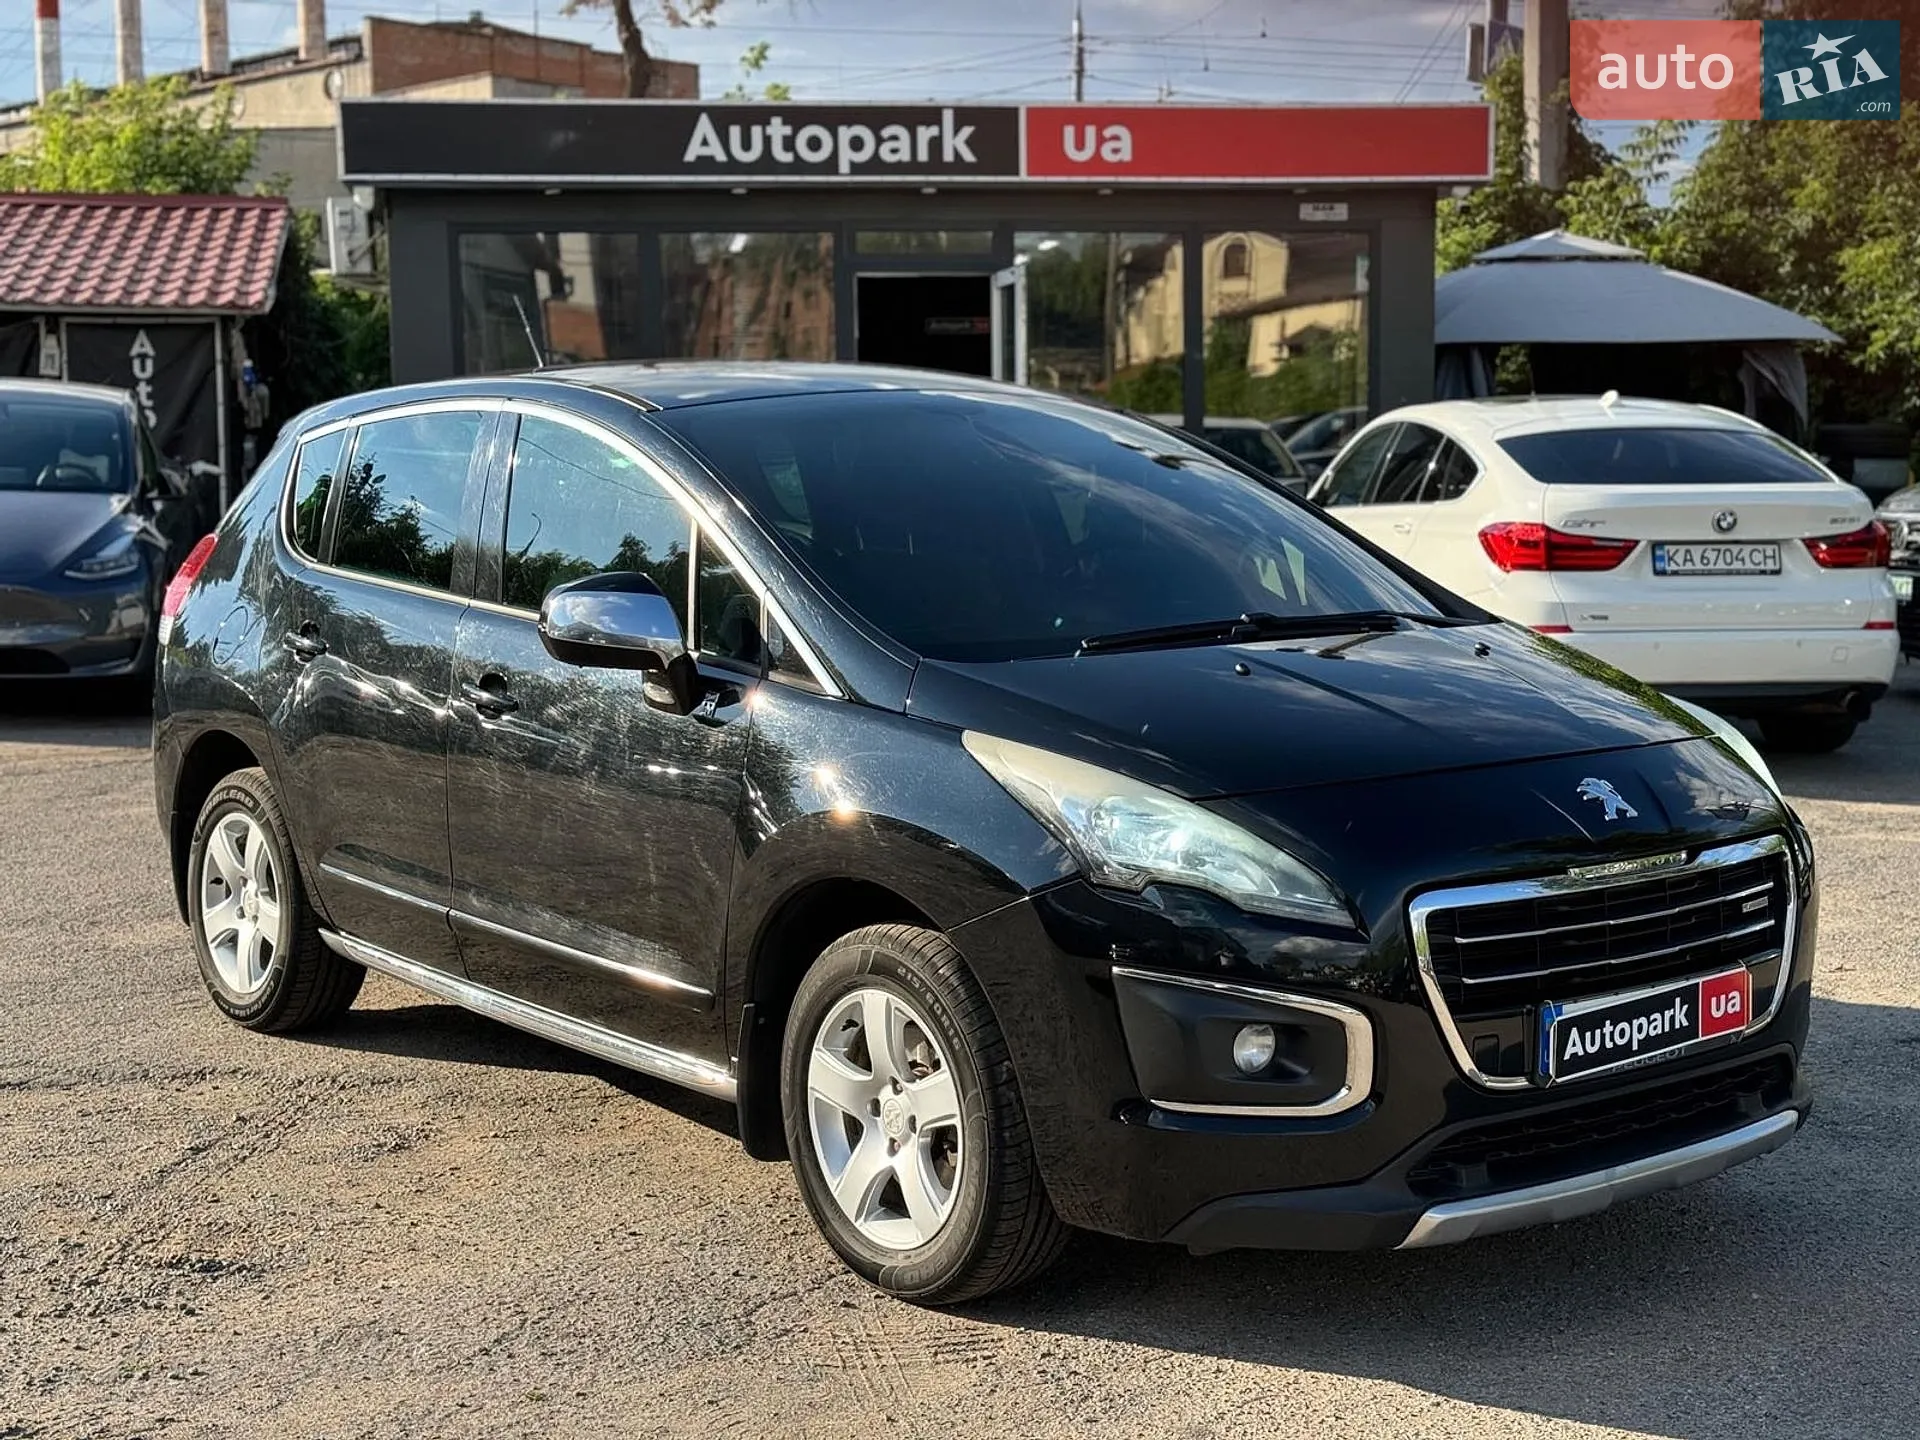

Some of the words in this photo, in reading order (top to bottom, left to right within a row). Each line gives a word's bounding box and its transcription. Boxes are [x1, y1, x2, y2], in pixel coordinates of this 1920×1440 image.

[683, 108, 977, 175] Autopark
[1062, 124, 1133, 162] ua
[1667, 548, 1696, 567] KA
[1700, 548, 1746, 567] 6704
[1749, 548, 1777, 567] CH
[1562, 997, 1689, 1060] Autopark
[1711, 990, 1741, 1018] ua
